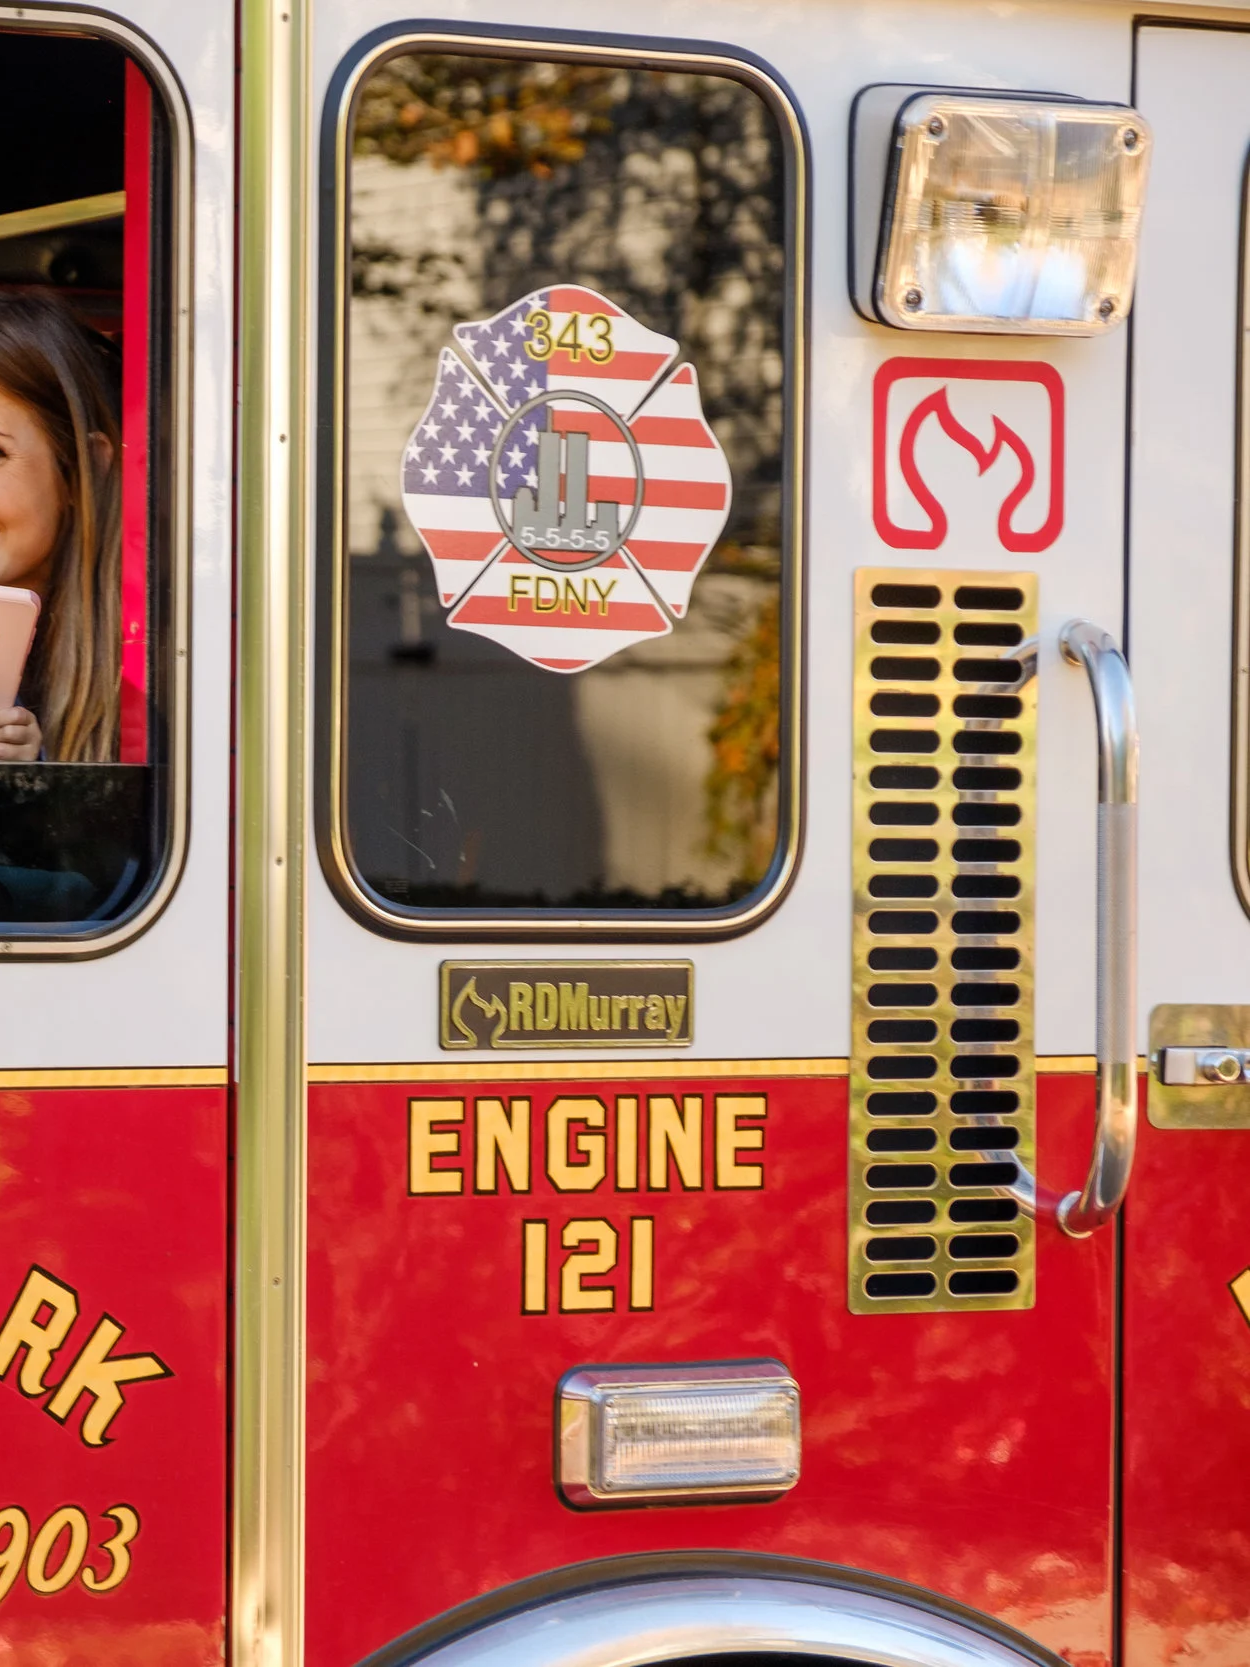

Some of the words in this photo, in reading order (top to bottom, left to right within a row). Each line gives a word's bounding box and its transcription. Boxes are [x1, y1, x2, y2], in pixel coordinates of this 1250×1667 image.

[523, 308, 615, 365] 343
[520, 526, 610, 550] 5-5-5-5
[507, 574, 618, 616] FDNY
[508, 981, 688, 1042] RDMurray
[407, 1092, 768, 1197] ENGINE
[520, 1215, 655, 1315] 121
